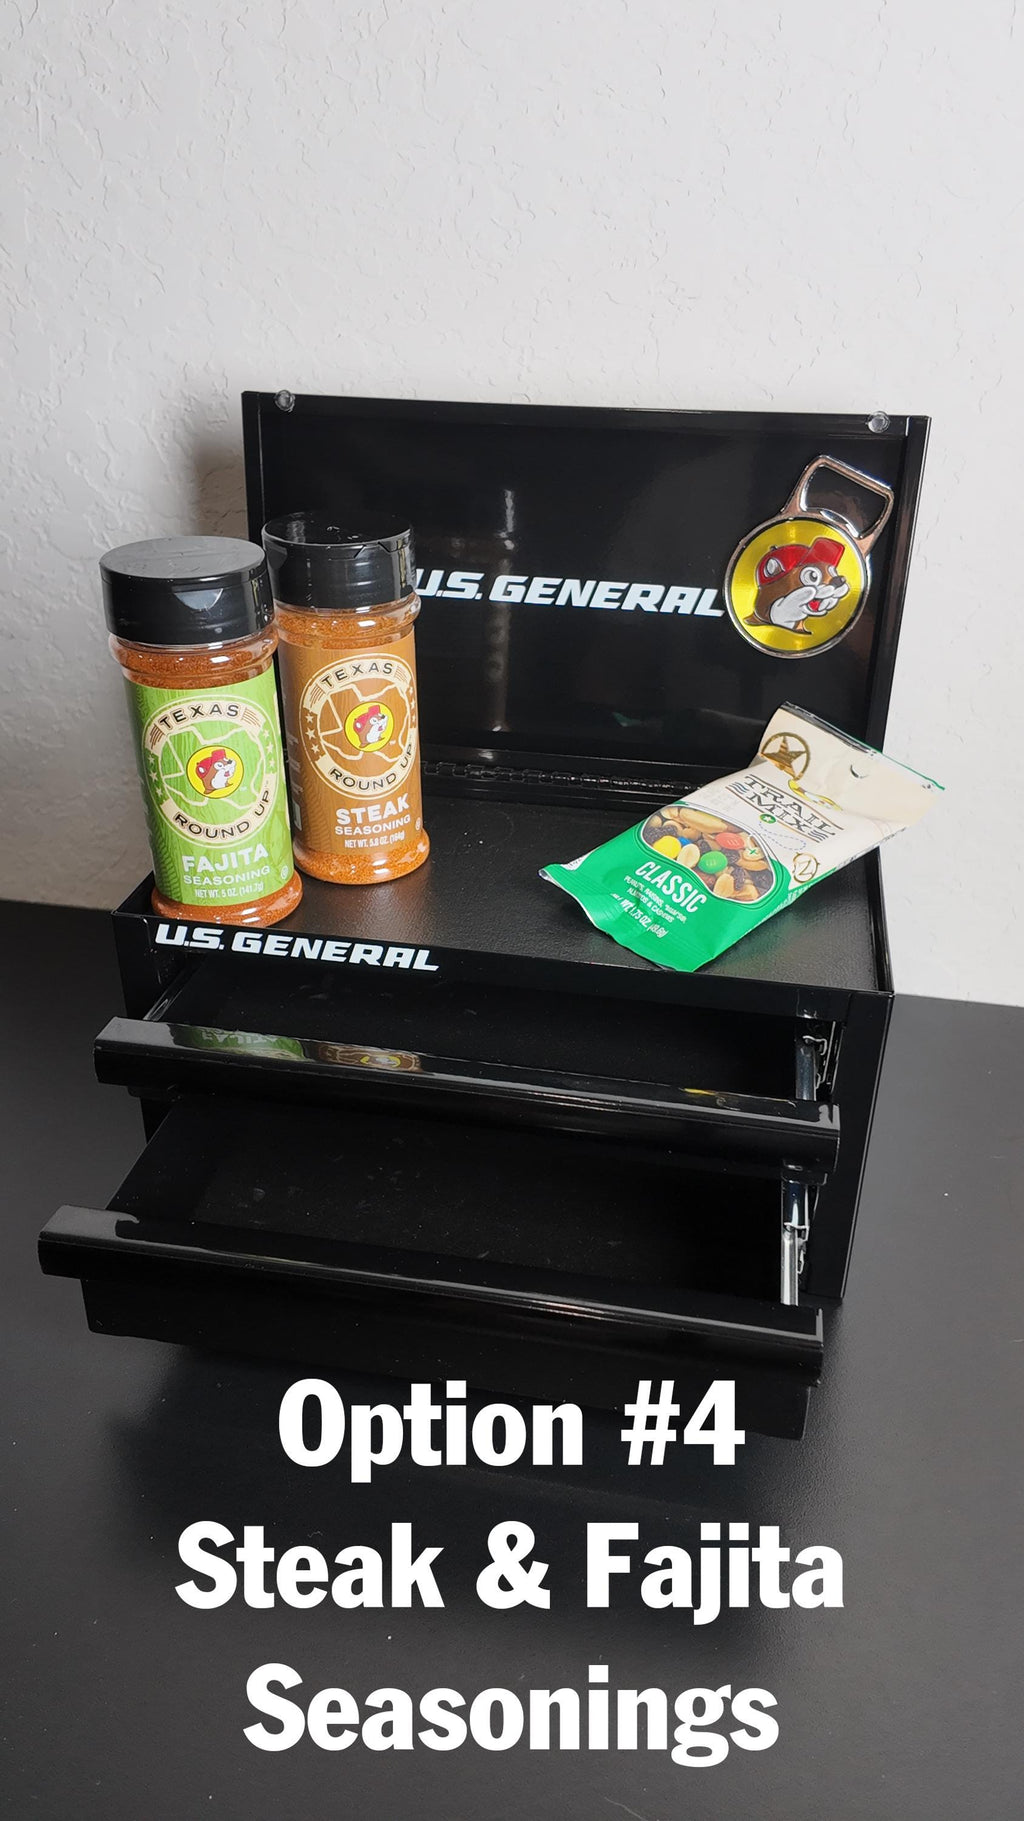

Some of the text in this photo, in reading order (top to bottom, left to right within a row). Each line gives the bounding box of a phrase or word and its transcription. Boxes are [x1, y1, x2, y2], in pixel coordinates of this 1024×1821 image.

[414, 568, 726, 617] U.S. GENERAL
[322, 662, 392, 687] TEXAS
[160, 704, 239, 729] TEXAS
[330, 743, 412, 790] ROUND UP
[175, 790, 269, 838] ROUND UP
[335, 793, 409, 825] STEAK
[744, 775, 836, 836] TRAIL
[746, 792, 812, 832] MIX
[334, 814, 411, 835] SEASONING
[181, 843, 269, 873] FAJITA
[344, 839, 356, 848] NET
[183, 865, 271, 886] SEASONING
[635, 861, 707, 913] CLASSIC
[195, 889, 207, 898] NET
[155, 924, 440, 972] U.S. GENERAL
